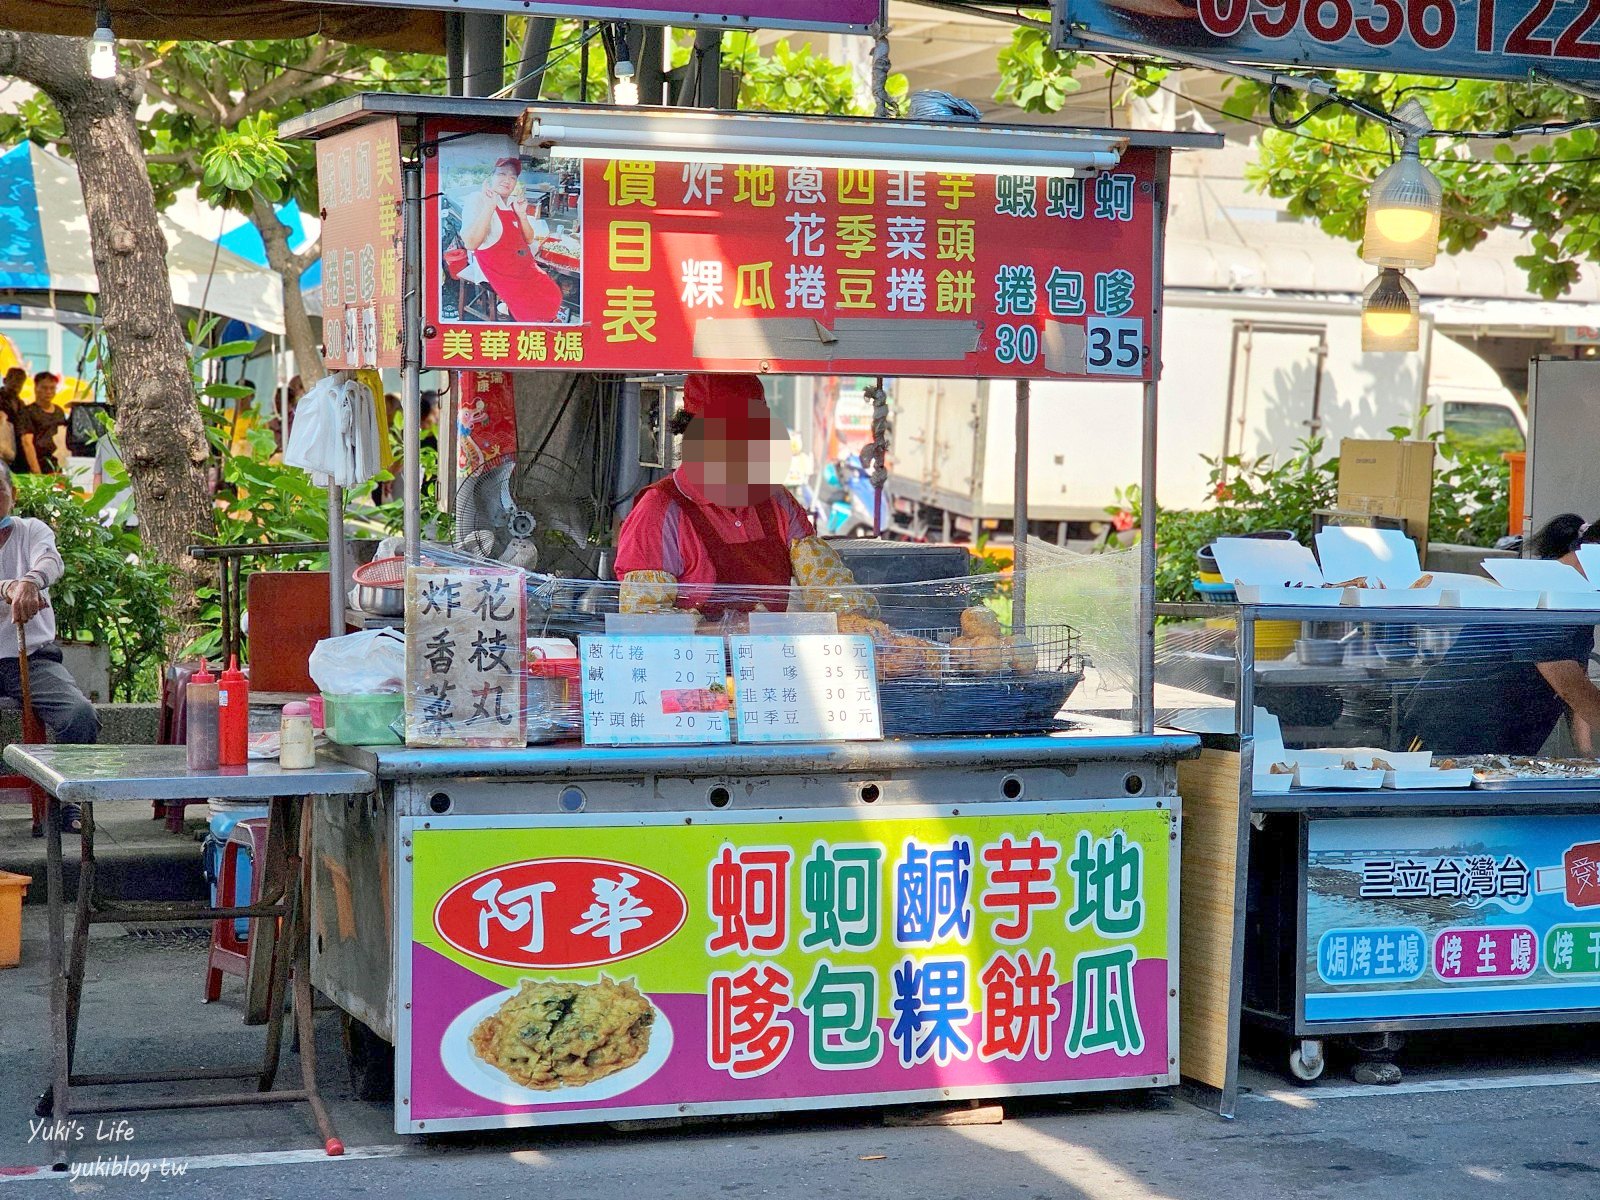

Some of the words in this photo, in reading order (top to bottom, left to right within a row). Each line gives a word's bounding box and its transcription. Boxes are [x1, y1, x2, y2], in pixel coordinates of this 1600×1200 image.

[376, 137, 397, 352] 美華媽媽
[603, 161, 657, 342] 價目表
[681, 163, 724, 308] 炸粿
[734, 165, 775, 309] 地瓜
[836, 168, 876, 308] 四季豆
[886, 170, 926, 311] 韭菜捲
[936, 172, 976, 314] 芋頭餅
[995, 173, 1037, 315] 蝦捲
[1046, 177, 1086, 316] 蚵包
[442, 330, 584, 362] 美華媽媽
[995, 323, 1038, 364] 30
[1089, 327, 1140, 368] 35
[467, 577, 515, 726] 花枝丸
[588, 688, 648, 705] 地瓜
[588, 711, 646, 729] 芋頭餅
[742, 687, 797, 703] 韭菜捲
[744, 709, 799, 725] 四季豆
[472, 872, 653, 954] 阿華
[1068, 830, 1145, 1058] 地瓜
[1360, 854, 1531, 898] 三立台灣台
[801, 842, 882, 1068] 蚵包
[893, 837, 972, 1066] 鹹粿
[979, 832, 1060, 1062] 芋餅
[1326, 934, 1420, 977] 焗烤生蠔
[1440, 932, 1532, 976] 烤生蠔
